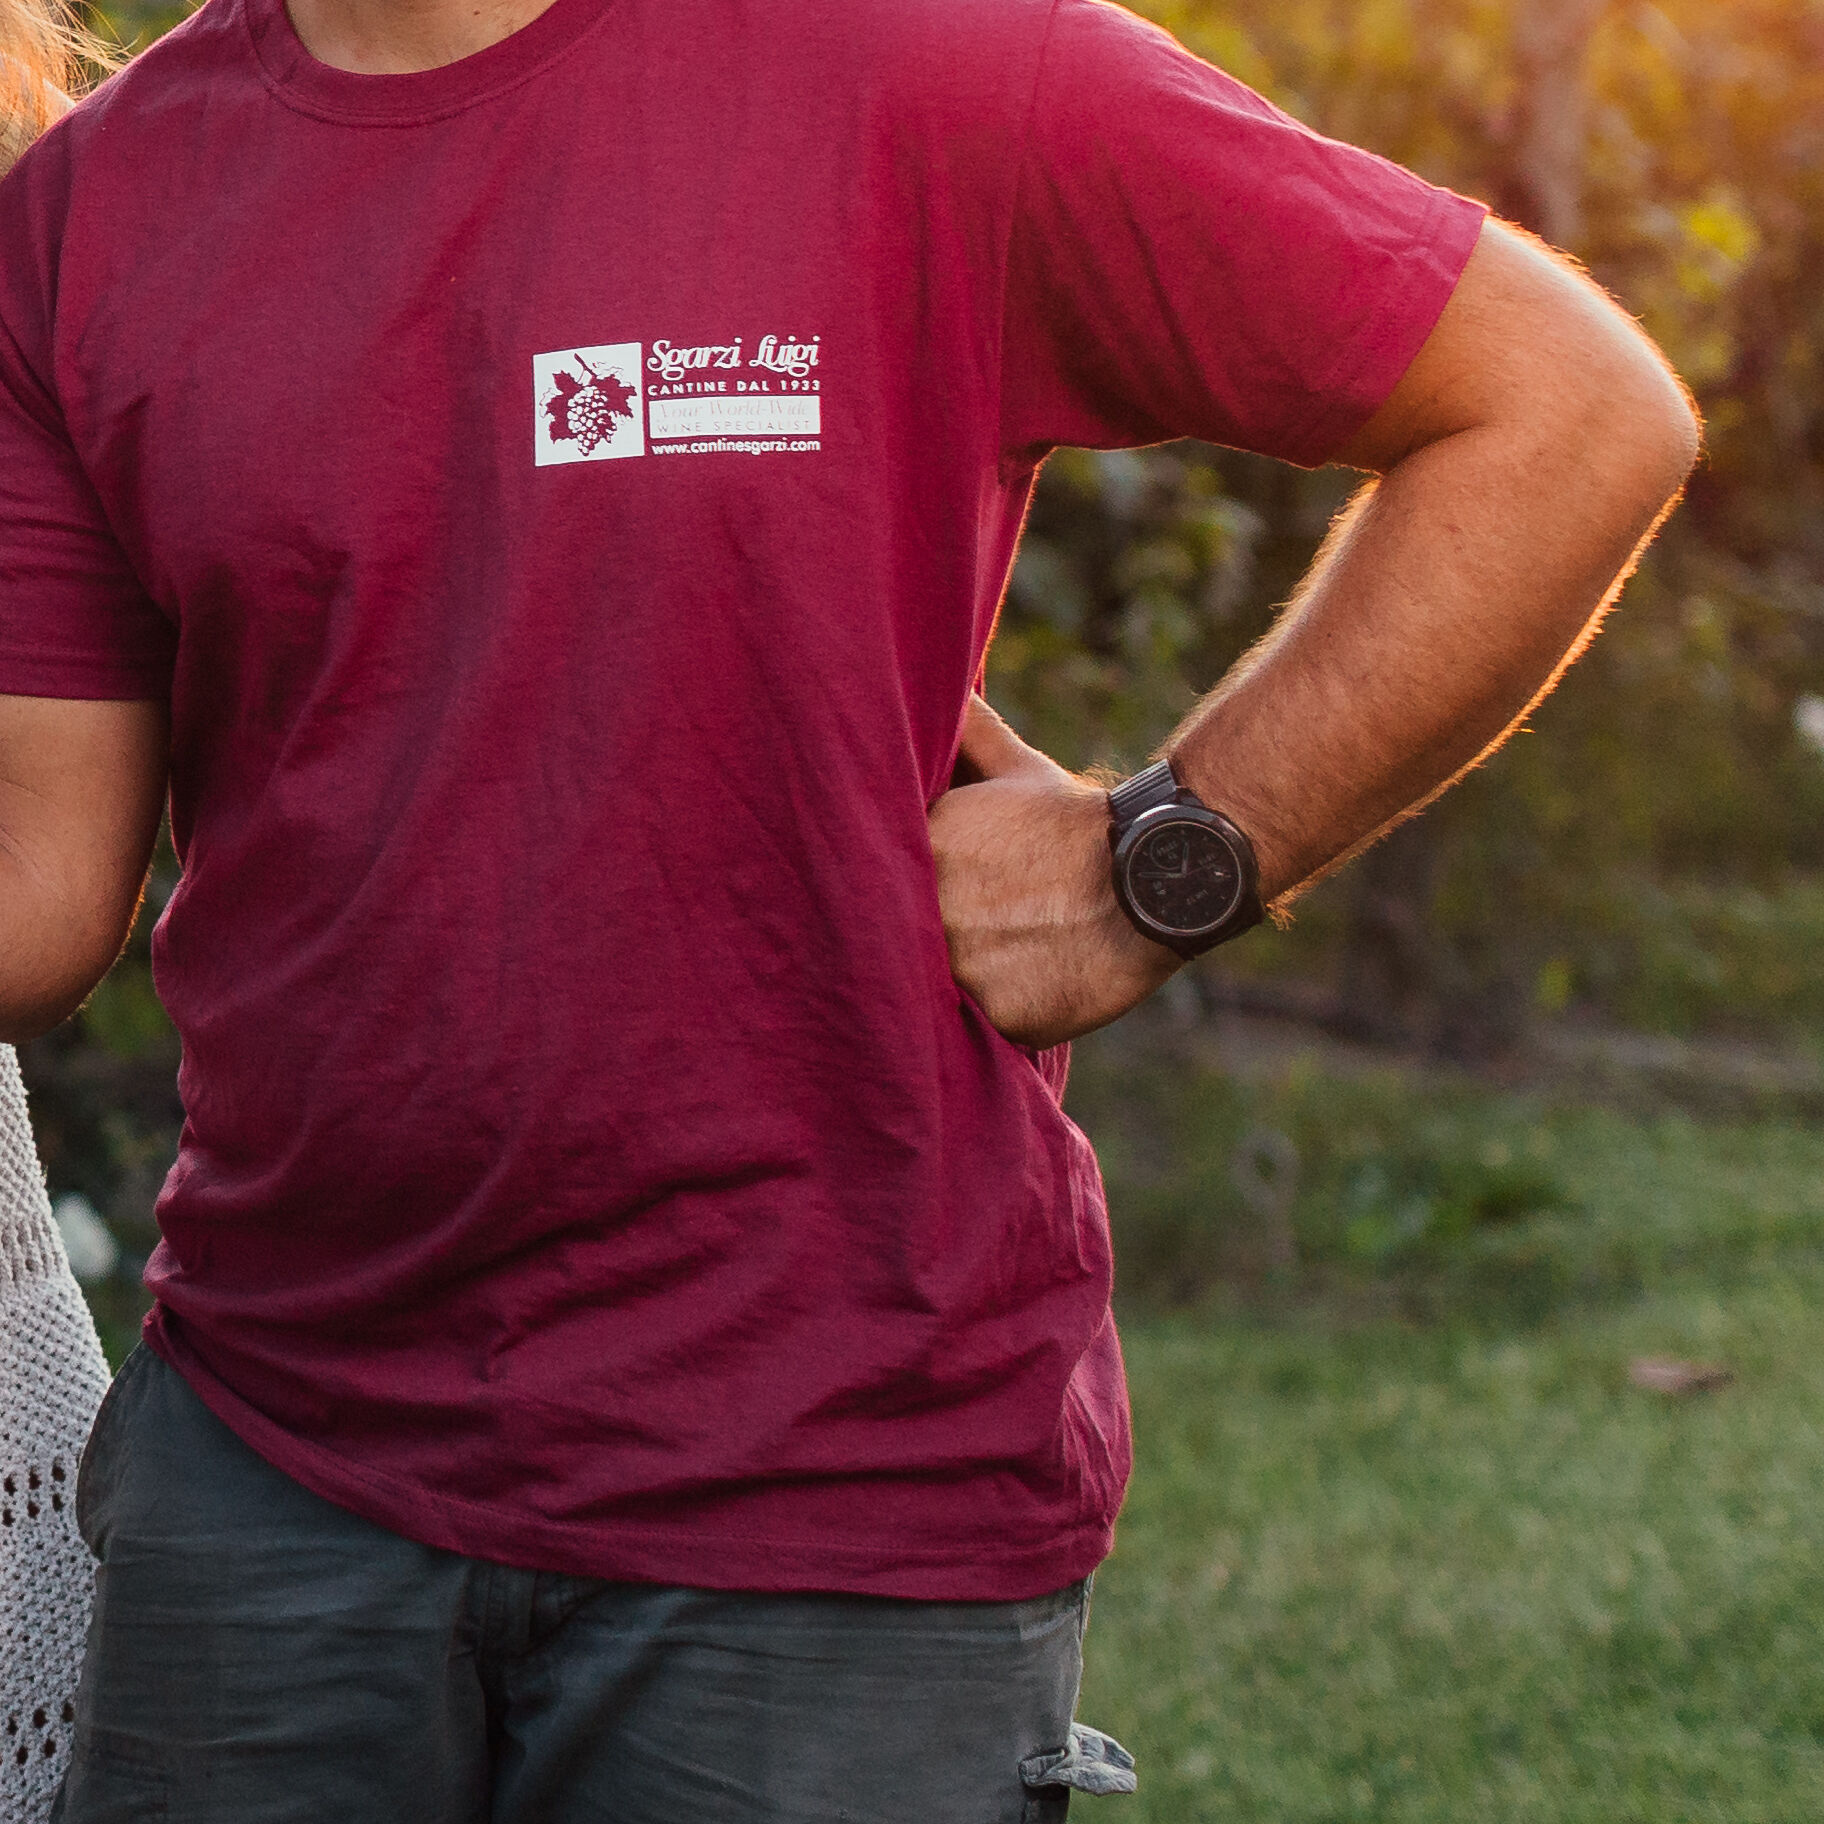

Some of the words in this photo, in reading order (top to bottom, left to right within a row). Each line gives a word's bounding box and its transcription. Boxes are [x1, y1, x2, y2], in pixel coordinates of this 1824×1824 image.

[647, 337, 742, 381] Sgarzi
[749, 334, 820, 377] Luigi
[647, 381, 728, 396] CANTINE
[736, 380, 770, 392] DAL
[780, 379, 821, 391] 1933
[657, 422, 704, 433] WINE
[713, 420, 810, 432] SPECIALIST
[651, 437, 821, 456] www.cantinesgarzi.com
